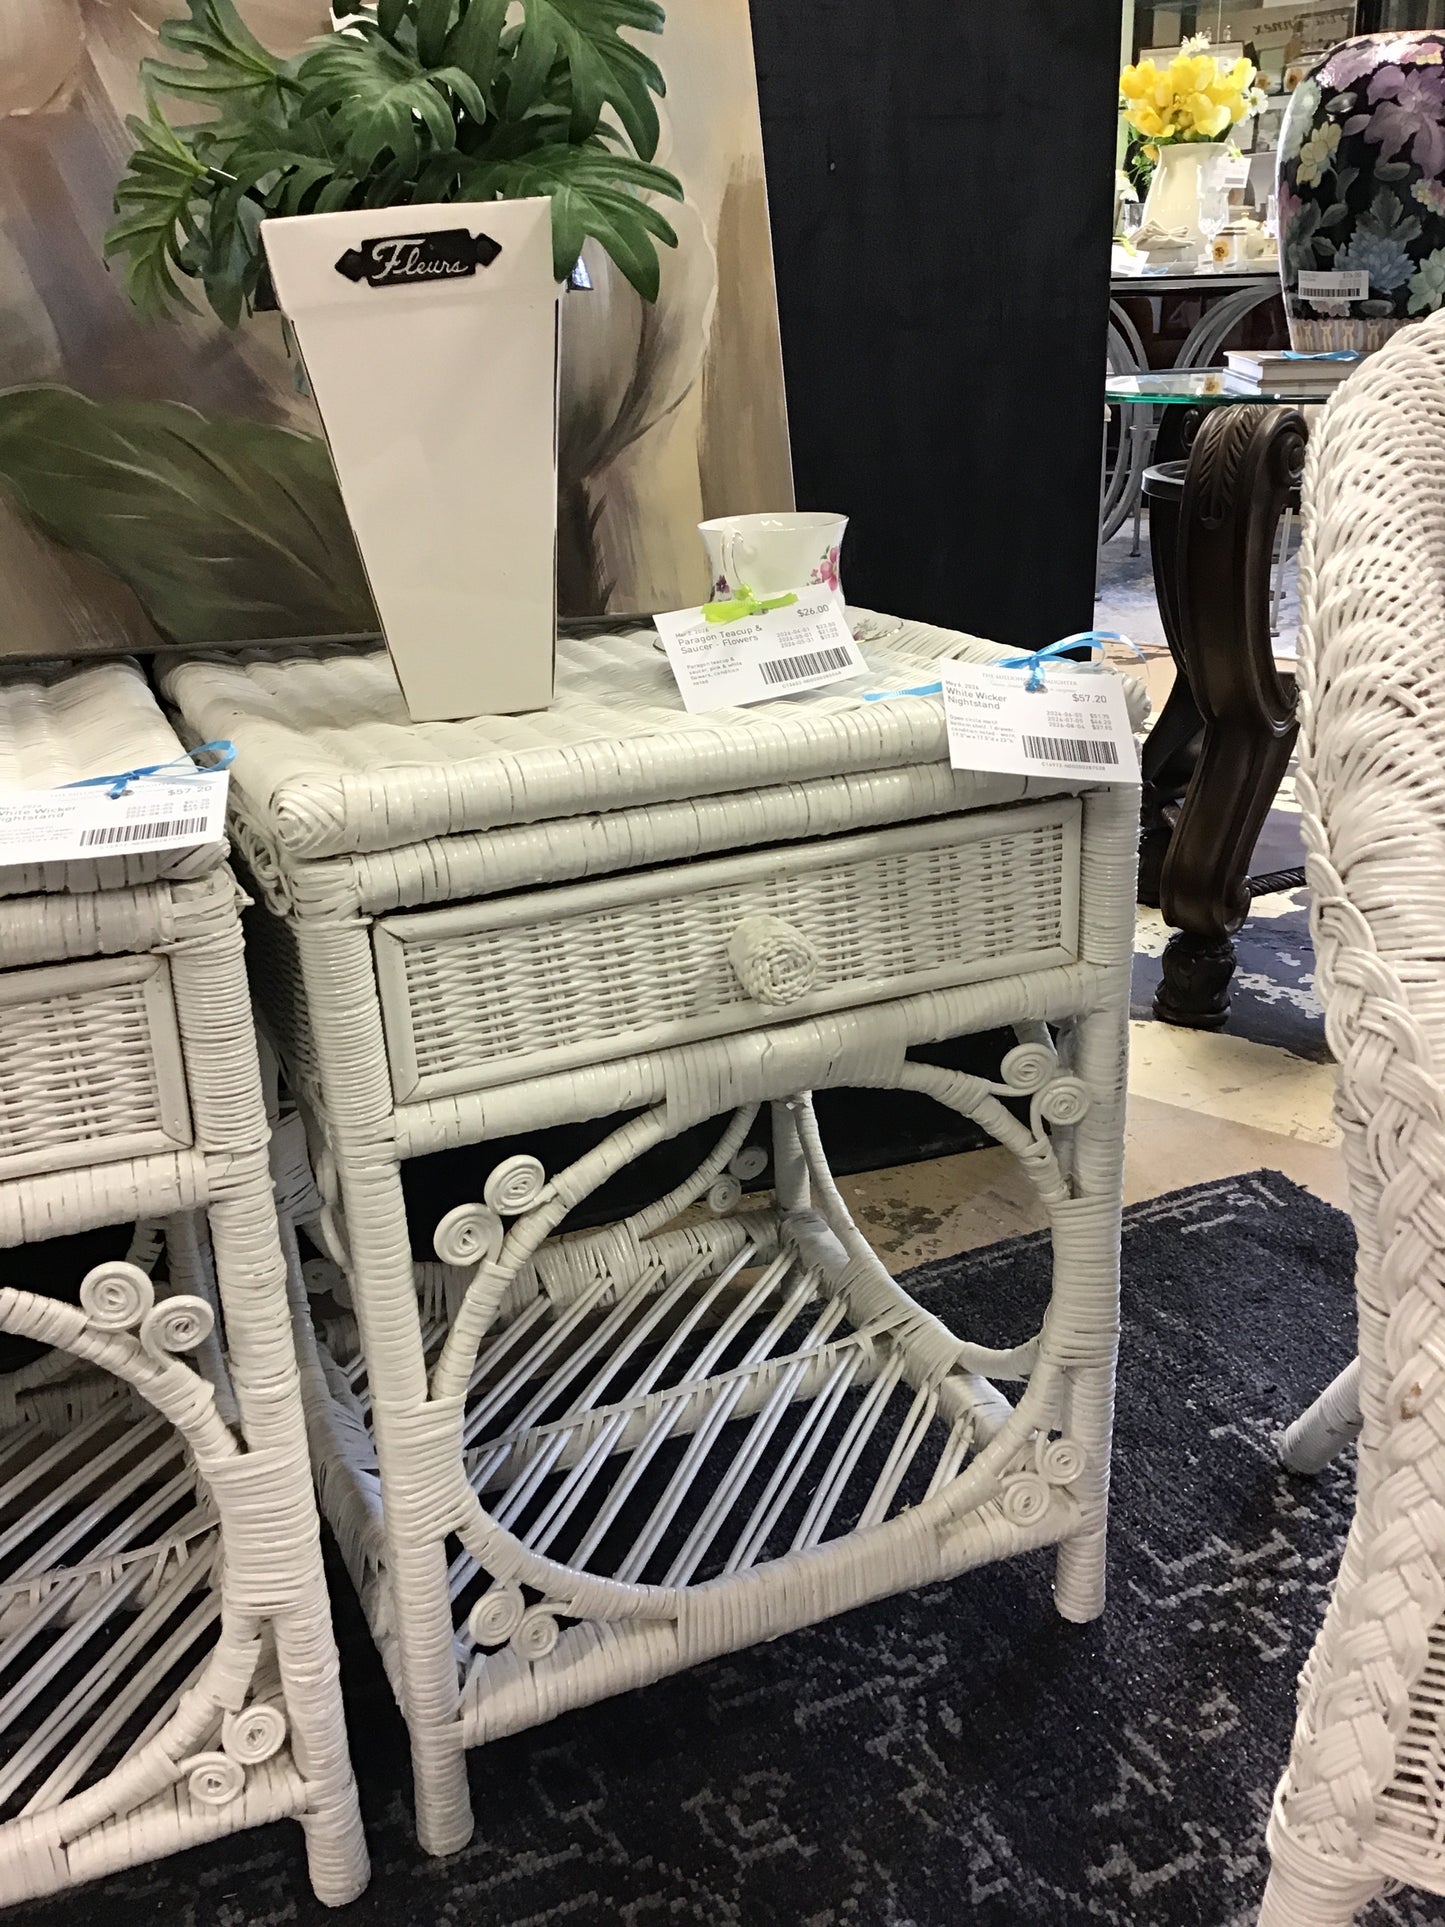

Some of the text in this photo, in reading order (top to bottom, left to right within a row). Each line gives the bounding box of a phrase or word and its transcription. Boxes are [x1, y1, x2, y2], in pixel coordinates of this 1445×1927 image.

[372, 238, 468, 280] Fleurs
[797, 604, 829, 617] $26.00
[678, 633, 717, 646] Paragon
[719, 627, 753, 639] Teacup
[680, 642, 713, 654] Saucer
[722, 635, 759, 646] Flowers
[946, 686, 1007, 702] White Wicker
[1072, 693, 1107, 703] $57.20
[947, 695, 1000, 709] Nightstand
[168, 785, 213, 796] $57.20
[35, 806, 75, 814] Wicker
[0, 812, 64, 823] ightstand
